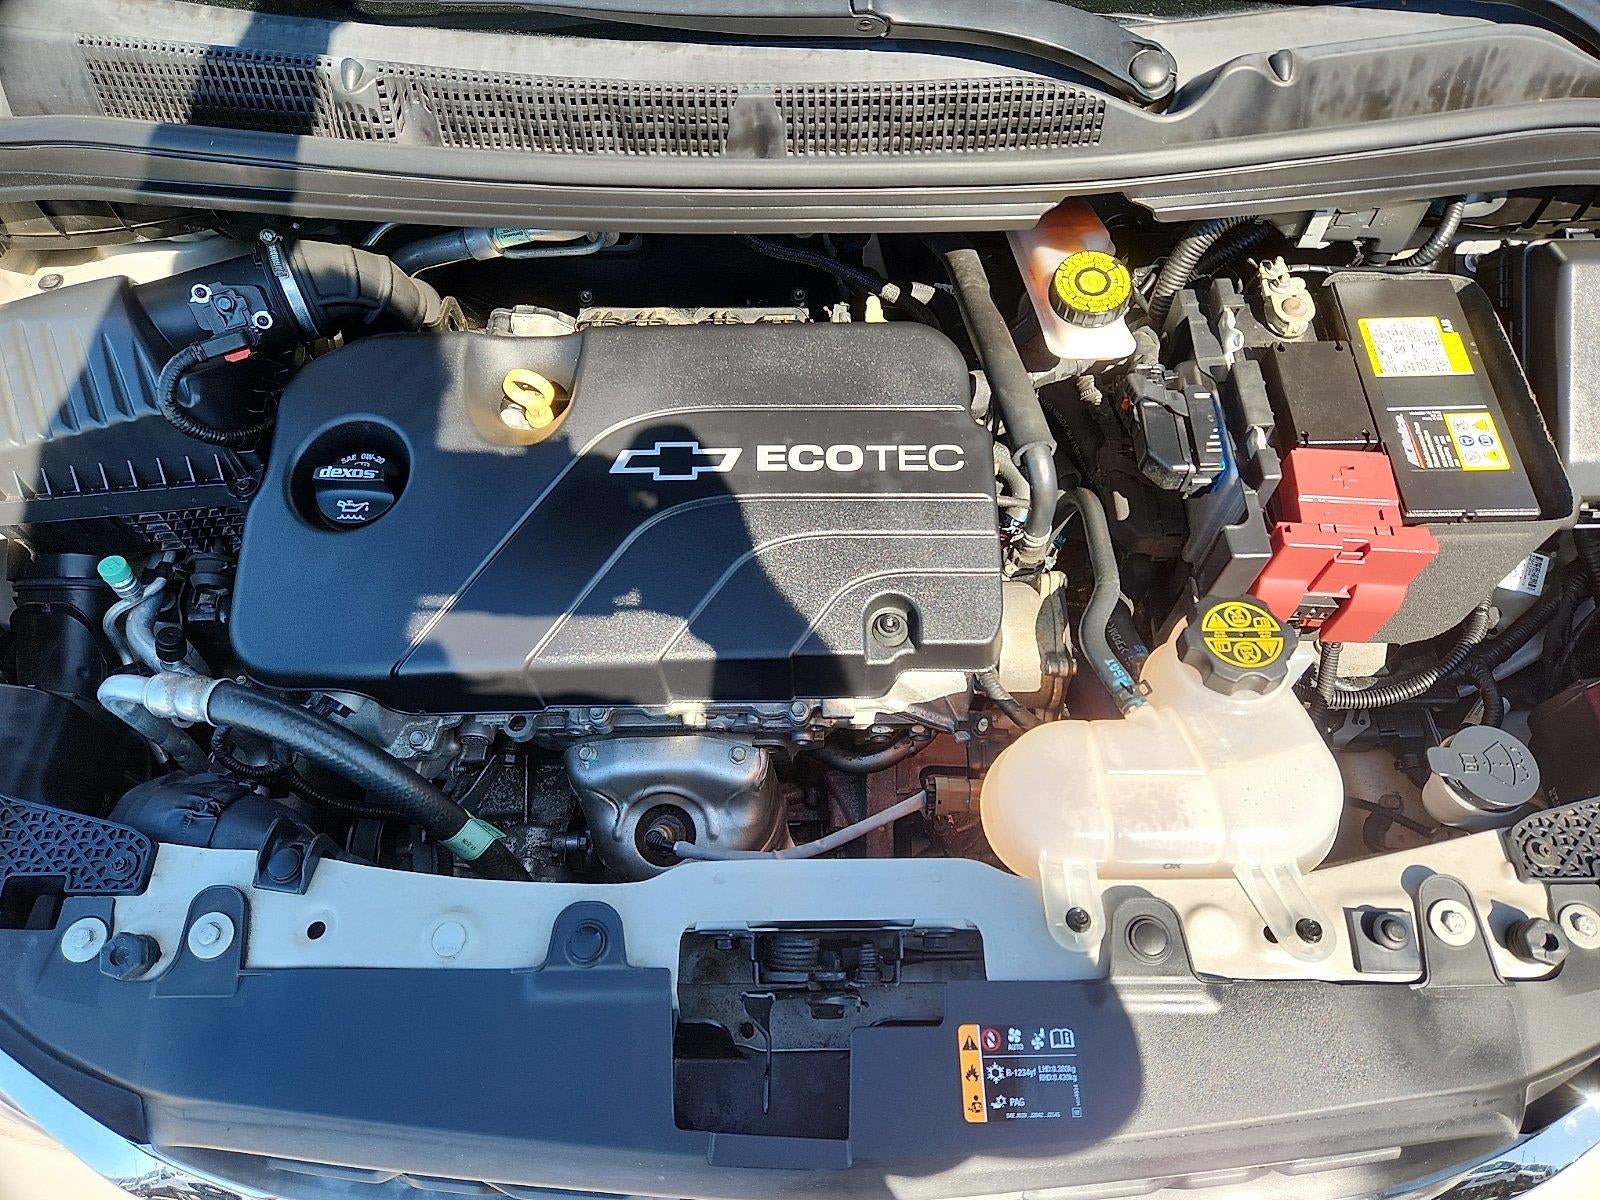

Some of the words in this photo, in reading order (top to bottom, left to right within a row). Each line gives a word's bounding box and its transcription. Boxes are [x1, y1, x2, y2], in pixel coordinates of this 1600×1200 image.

[341, 453, 357, 464] SAE
[360, 453, 386, 465] 0W-20
[756, 444, 965, 472] ECOTEC
[319, 465, 379, 479] dexos
[1163, 862, 1182, 870] OK
[1007, 1043, 1024, 1051] AUTO
[1009, 1097, 1026, 1107] PAG
